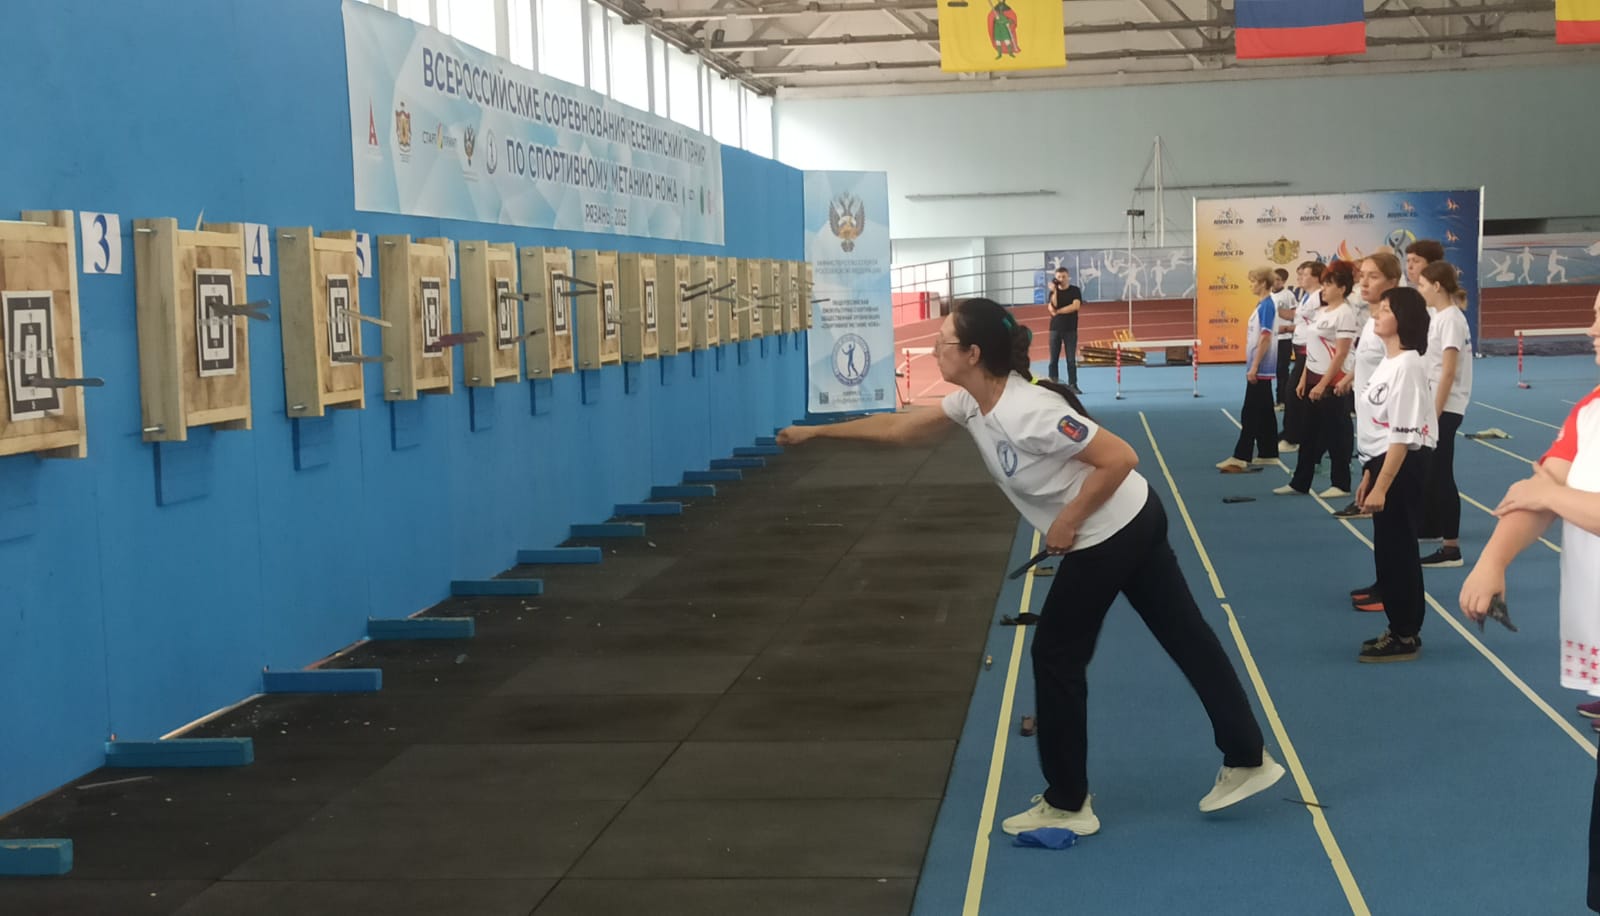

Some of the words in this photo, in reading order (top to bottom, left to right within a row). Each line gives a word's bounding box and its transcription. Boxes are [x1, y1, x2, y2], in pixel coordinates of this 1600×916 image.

[423, 47, 541, 121] ВСЕРОССИЙСКИЕ
[543, 91, 626, 143] СОРЕВНОВАНИЯ
[506, 139, 525, 176] ПО
[528, 144, 608, 191] СПОРТИВНОМУ
[611, 165, 653, 200] МЕТАНИЮ
[655, 174, 678, 201] НОЖА
[93, 214, 110, 273] 3
[585, 203, 610, 225] РЯЗАНЬ
[252, 226, 264, 275] 4
